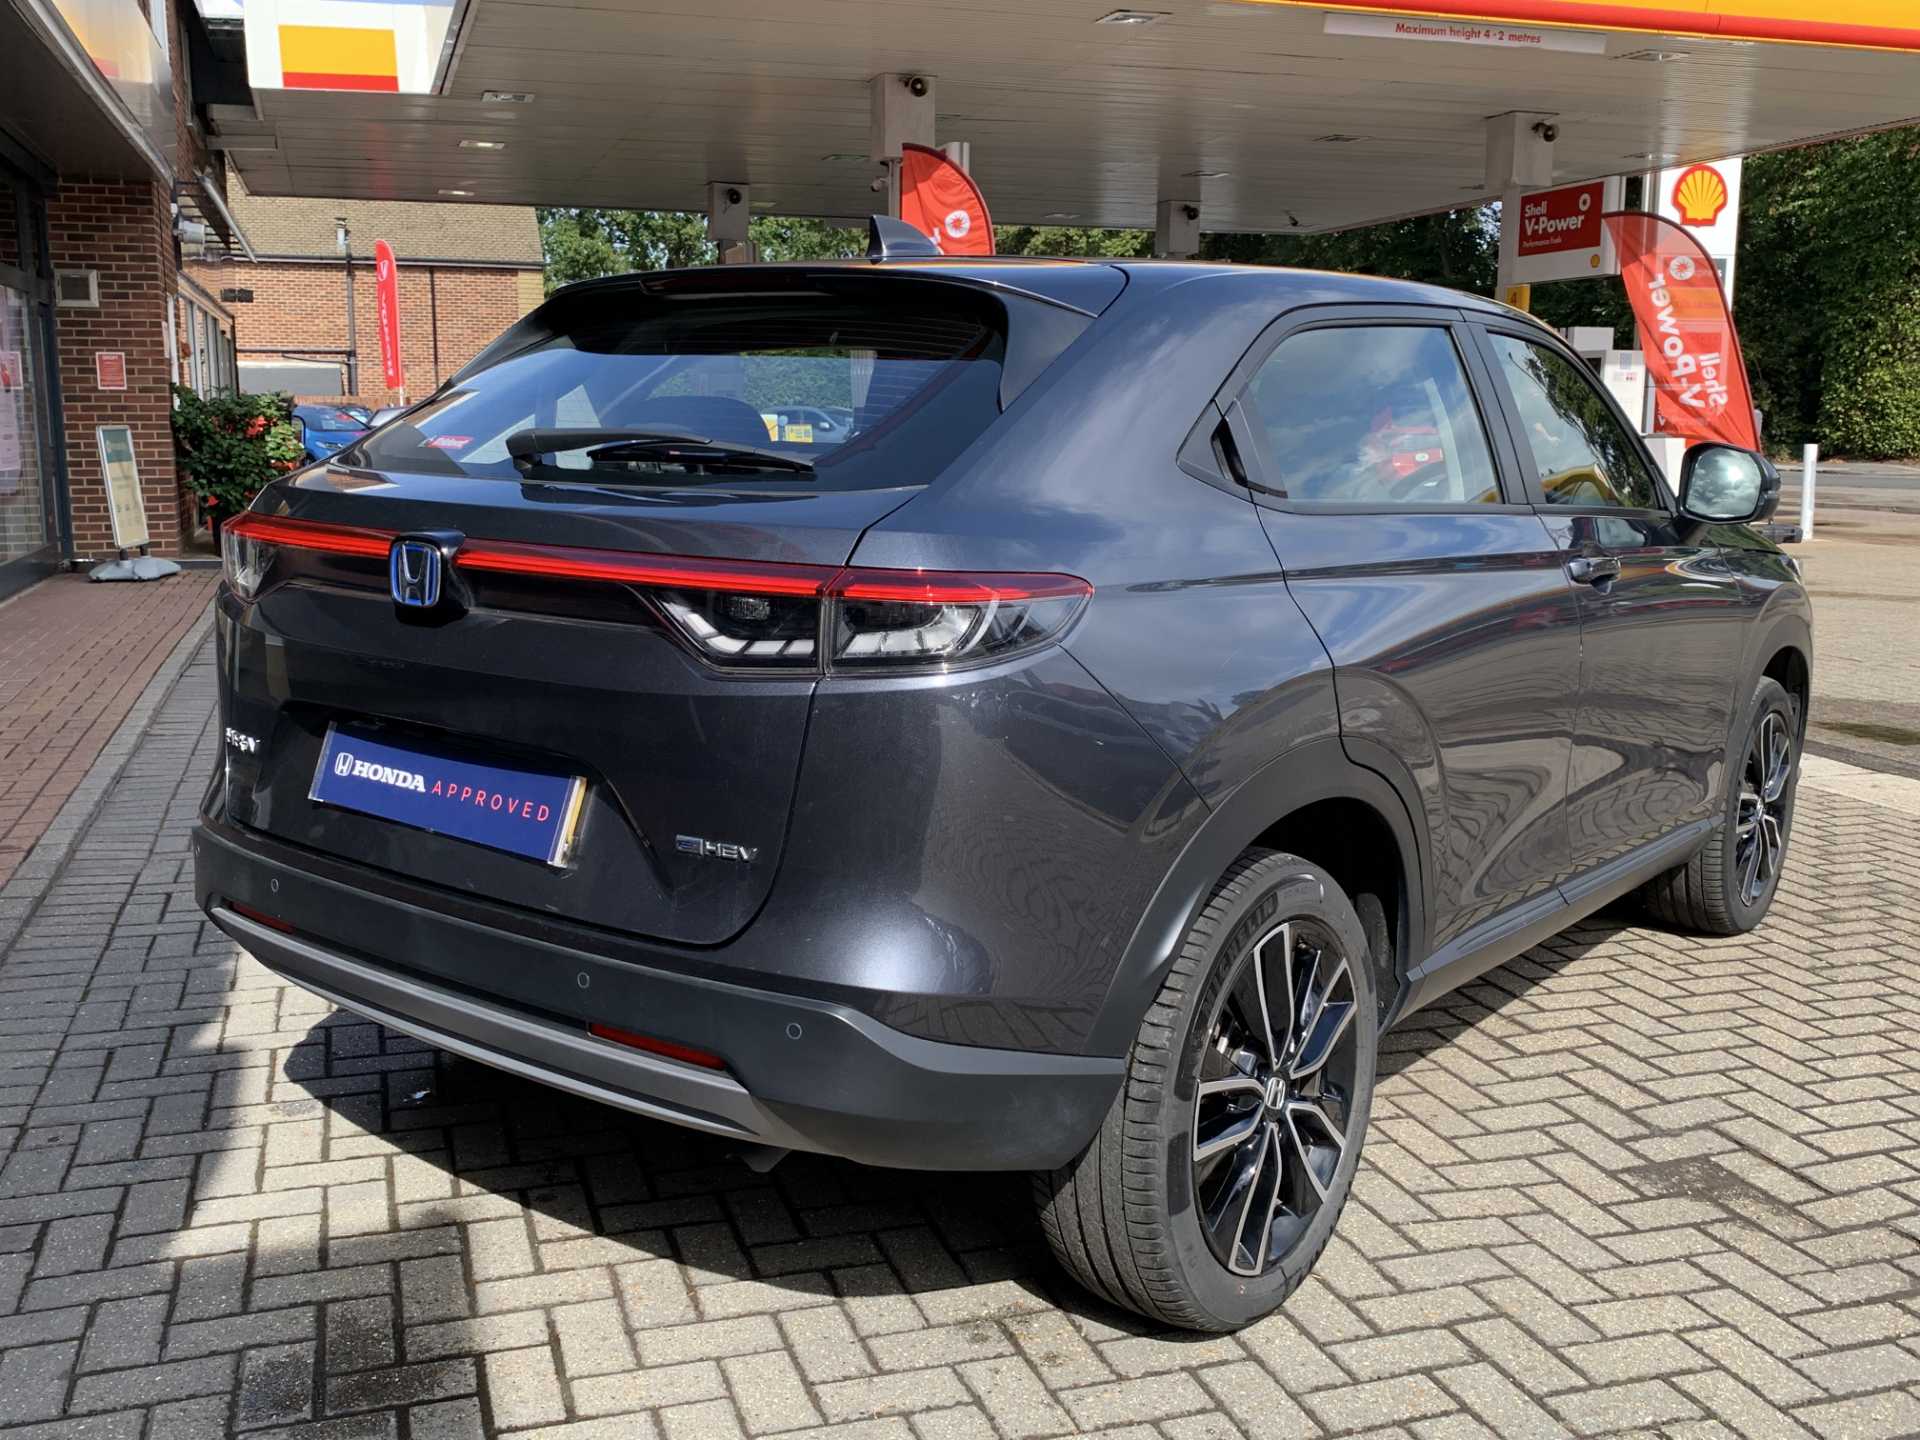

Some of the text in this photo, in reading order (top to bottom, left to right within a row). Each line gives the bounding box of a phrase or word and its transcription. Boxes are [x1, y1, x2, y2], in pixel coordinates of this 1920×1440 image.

[1395, 23, 1447, 36] Maximum
[1449, 26, 1481, 40] height
[1507, 33, 1542, 44] metres
[1524, 201, 1548, 217] Shell
[1524, 214, 1585, 236] V-Power
[352, 759, 426, 793] HONDA
[431, 780, 550, 822] APPROVED
